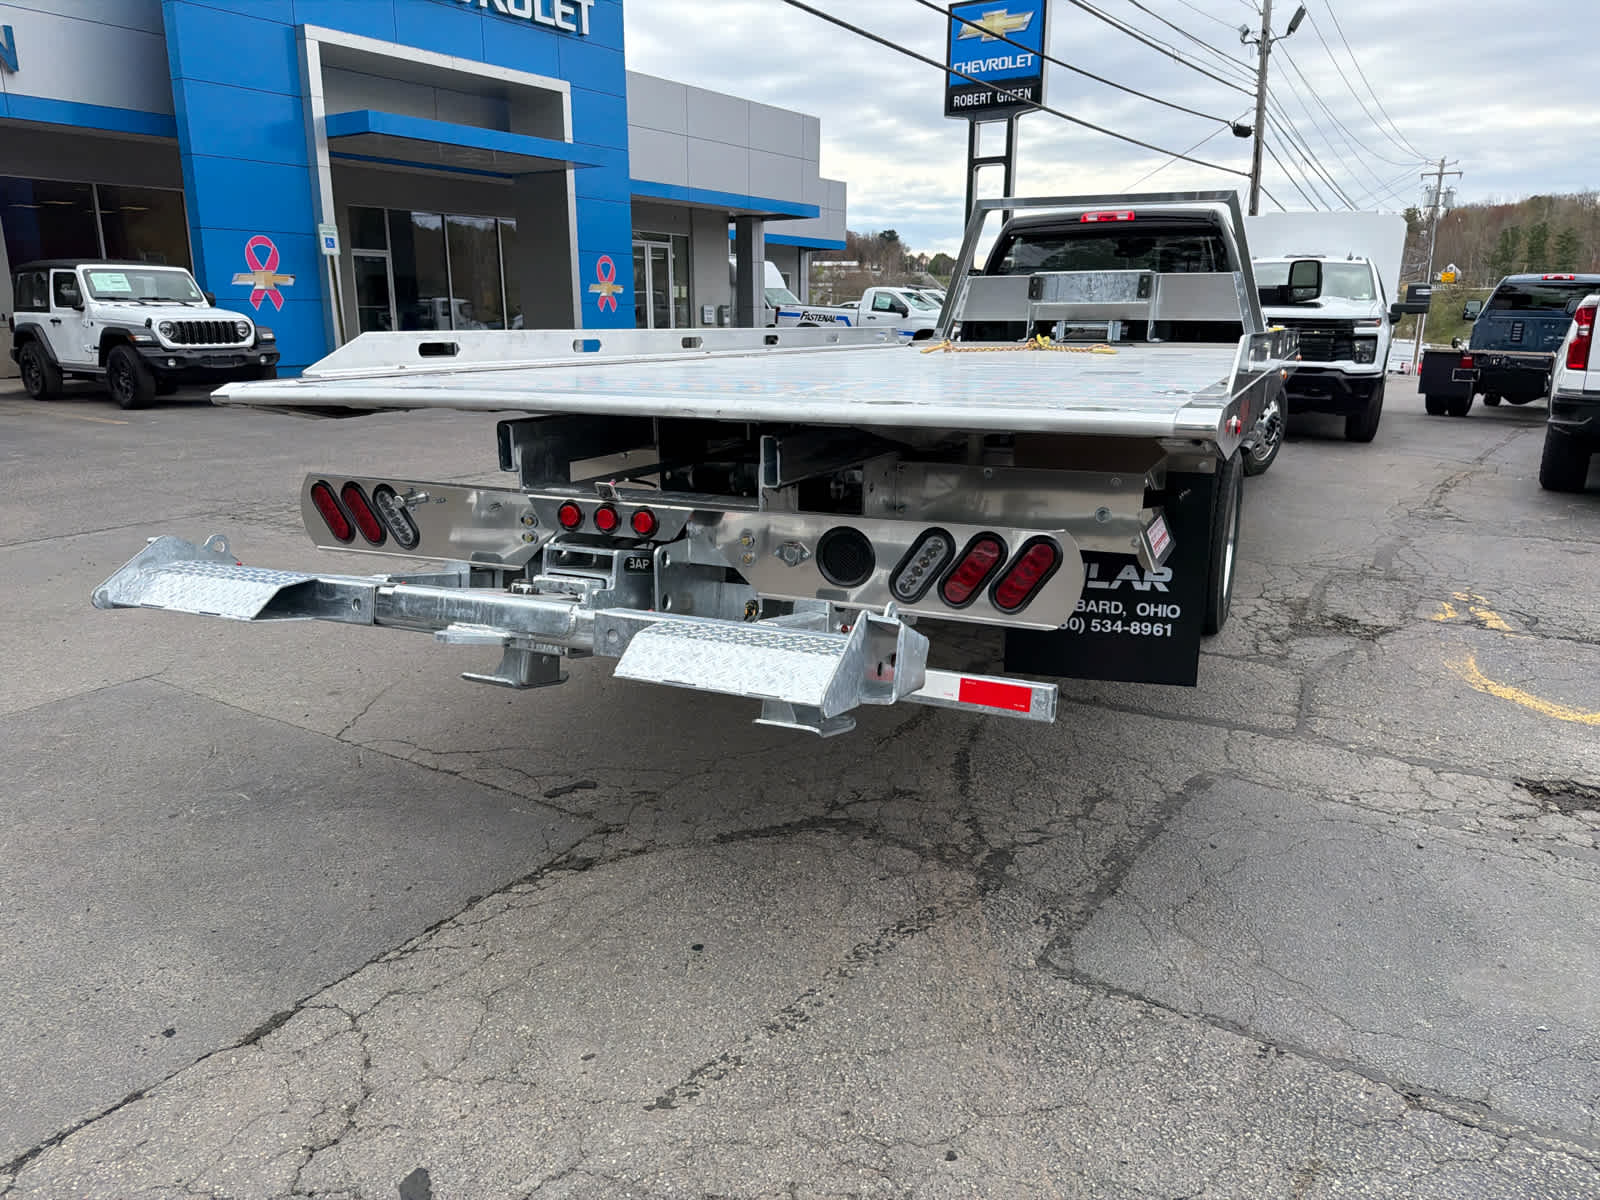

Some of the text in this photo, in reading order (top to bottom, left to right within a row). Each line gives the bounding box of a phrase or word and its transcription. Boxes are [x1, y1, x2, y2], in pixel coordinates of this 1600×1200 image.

[455, 0, 595, 36] OLET
[953, 53, 1034, 74] CHEVROLET
[953, 92, 992, 107] ROBERT
[800, 311, 836, 323] FASTENAL
[1083, 562, 1173, 592] LAR
[1136, 602, 1181, 619] OHIO
[1090, 618, 1173, 637] 534-8961
